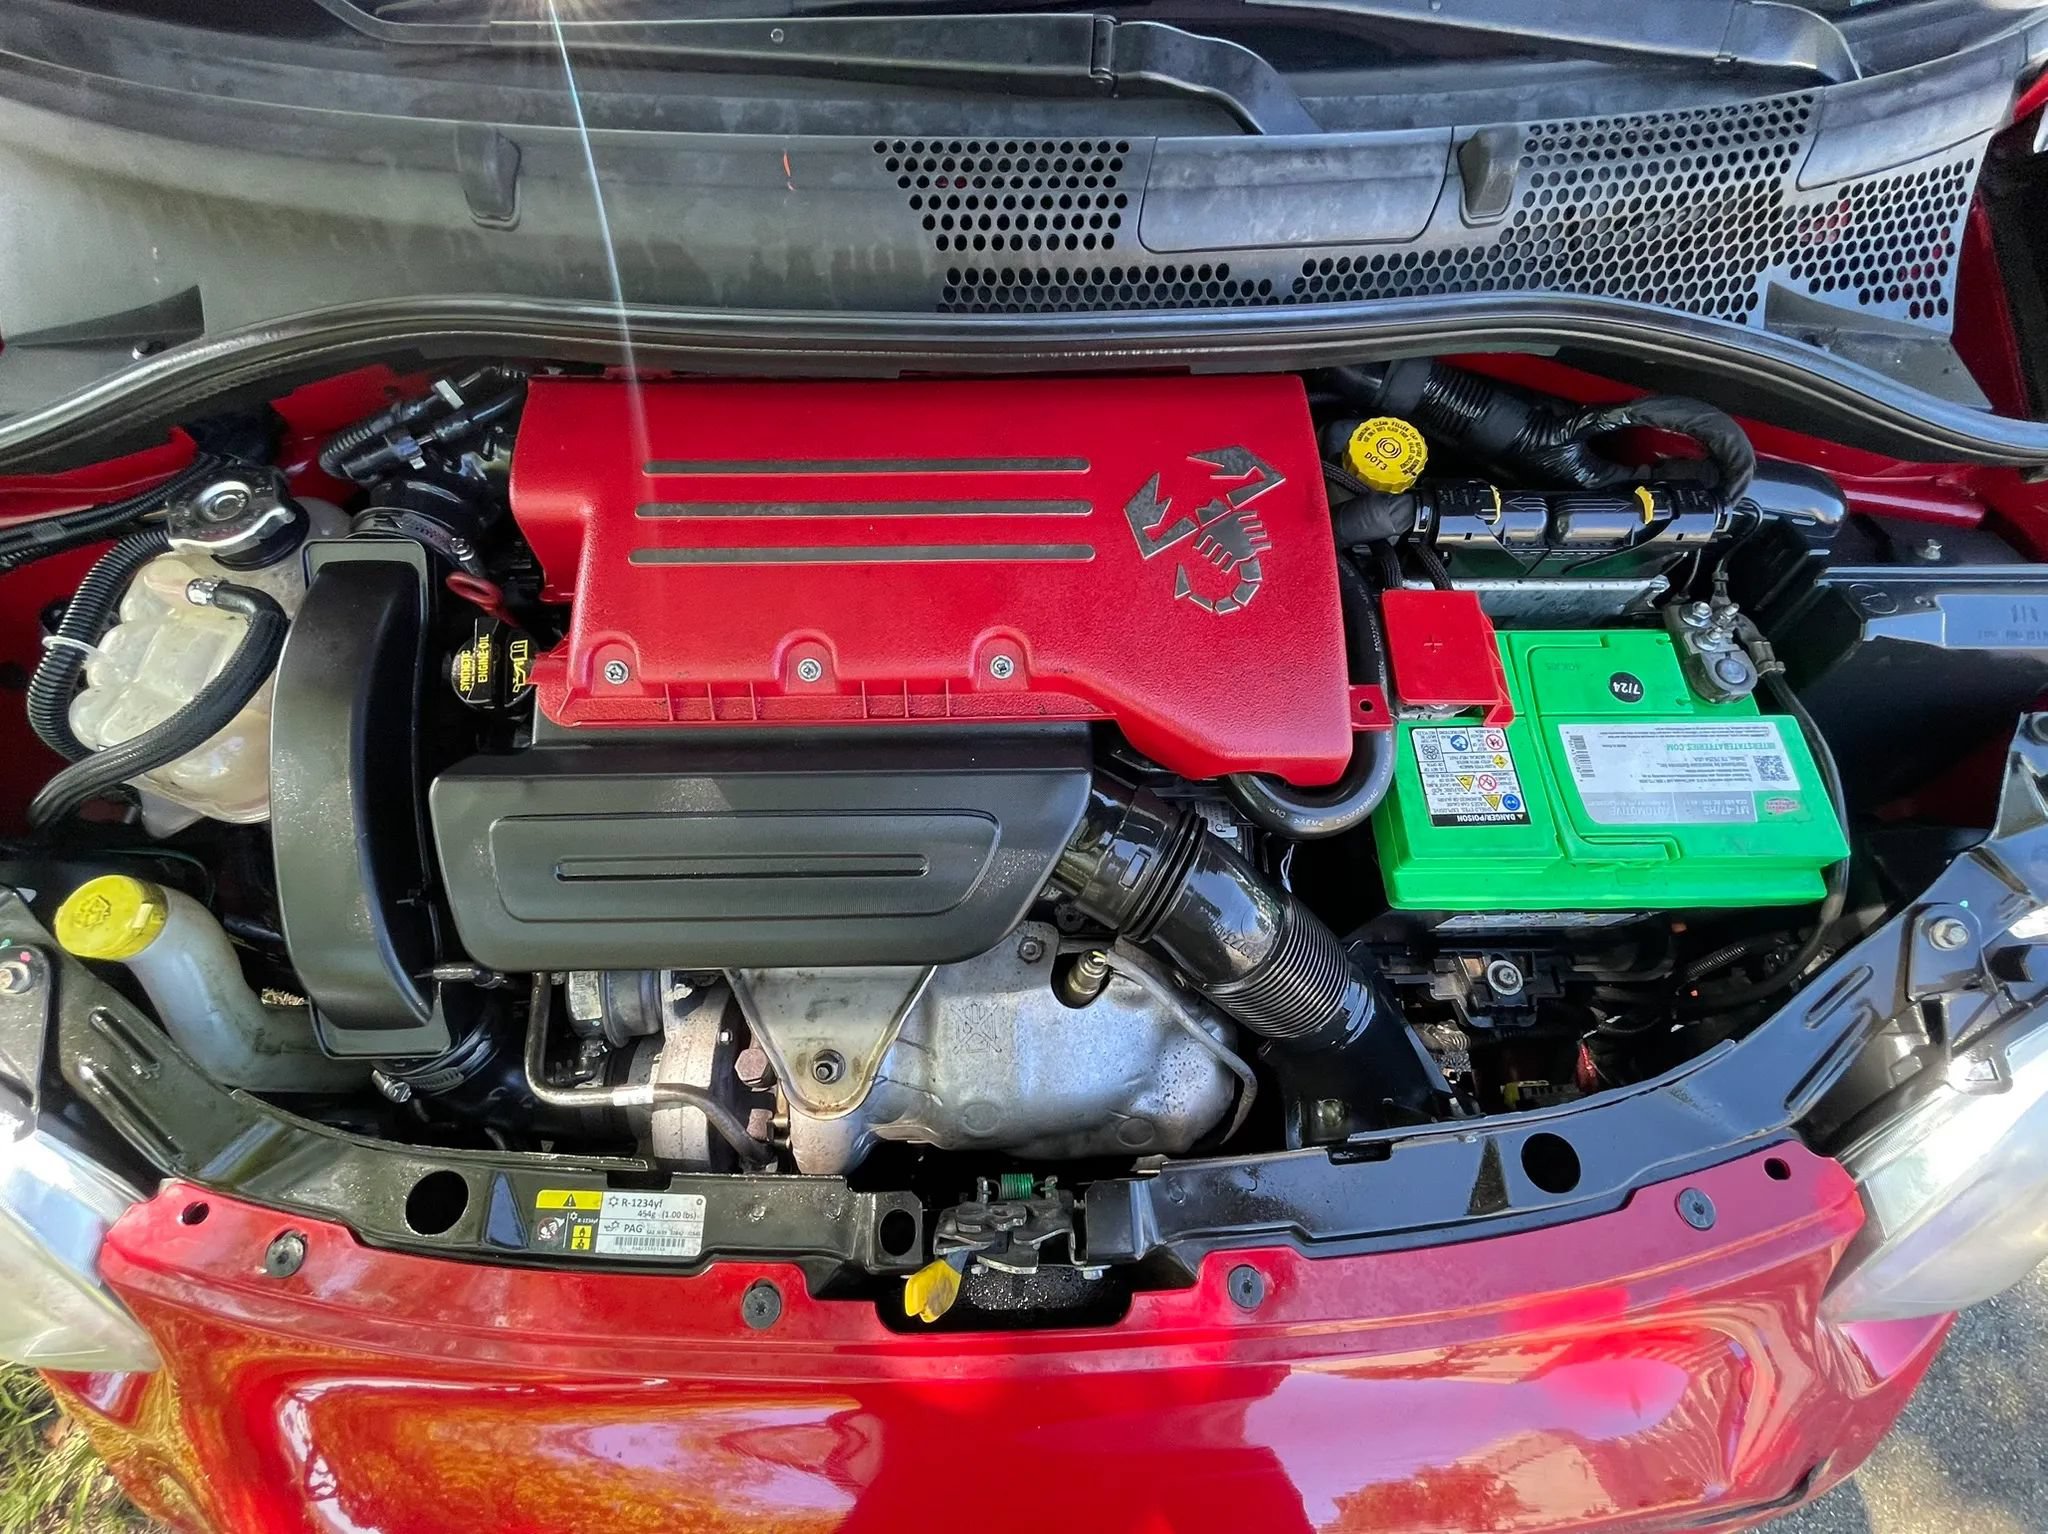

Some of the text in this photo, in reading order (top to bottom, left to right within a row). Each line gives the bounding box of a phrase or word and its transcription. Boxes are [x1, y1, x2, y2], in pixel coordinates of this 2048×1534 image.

[1392, 422, 1409, 432] FILLER
[460, 650, 471, 691] SYNTHETIC
[1613, 681, 1640, 694] 7/24
[1456, 814, 1516, 822] DANGER/POISON
[621, 1198, 663, 1209] R-1234yf
[662, 1211, 681, 1219] (1.00
[624, 1223, 643, 1233] PAG
